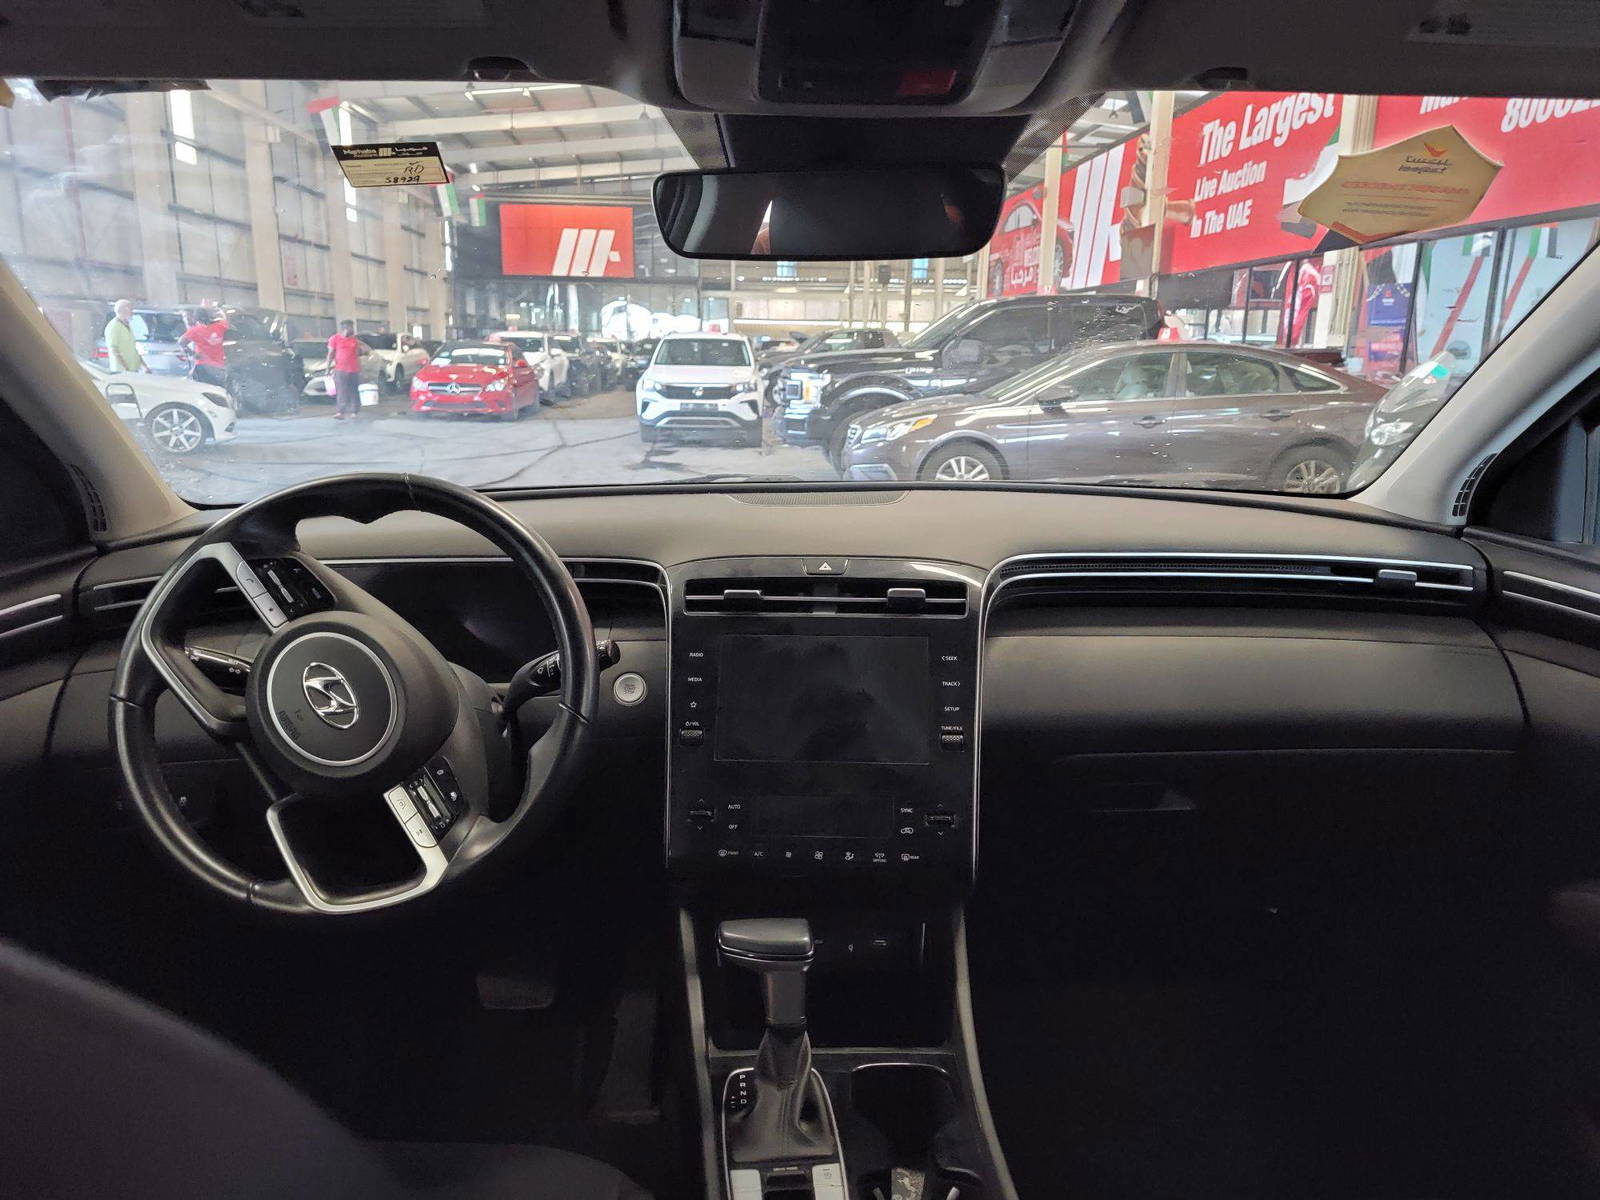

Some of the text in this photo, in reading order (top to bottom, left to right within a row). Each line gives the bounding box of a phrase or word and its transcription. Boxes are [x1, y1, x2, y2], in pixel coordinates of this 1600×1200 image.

[1199, 93, 1335, 167] The Largest
[1193, 160, 1267, 203] Live Auction
[1190, 198, 1254, 239] In The UAE
